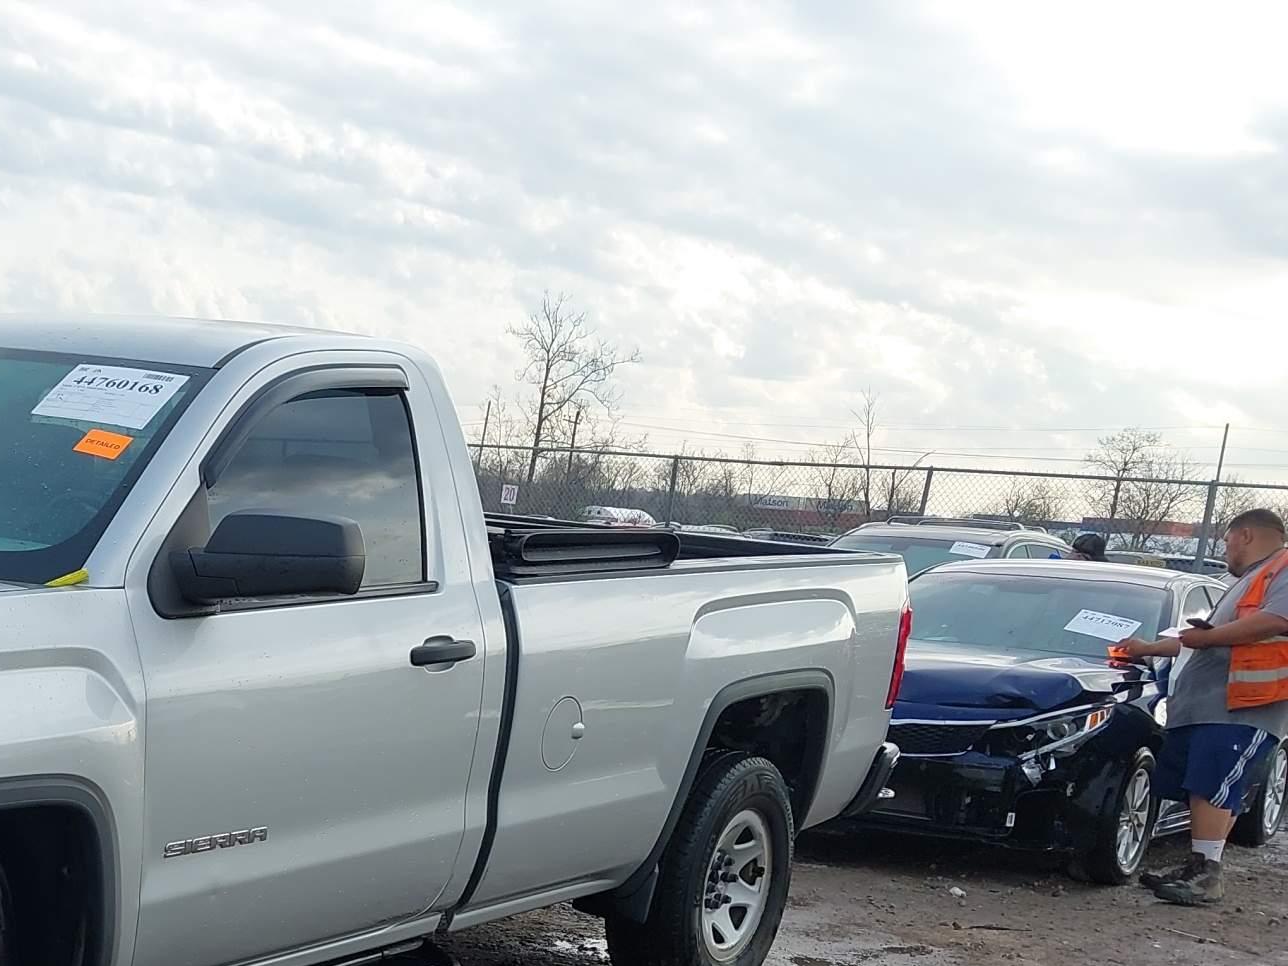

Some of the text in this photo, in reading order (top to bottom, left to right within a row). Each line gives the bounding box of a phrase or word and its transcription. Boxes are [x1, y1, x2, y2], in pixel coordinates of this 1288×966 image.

[73, 375, 164, 395] 44760168
[503, 486, 516, 502] 20
[163, 826, 268, 859] SIERRA
